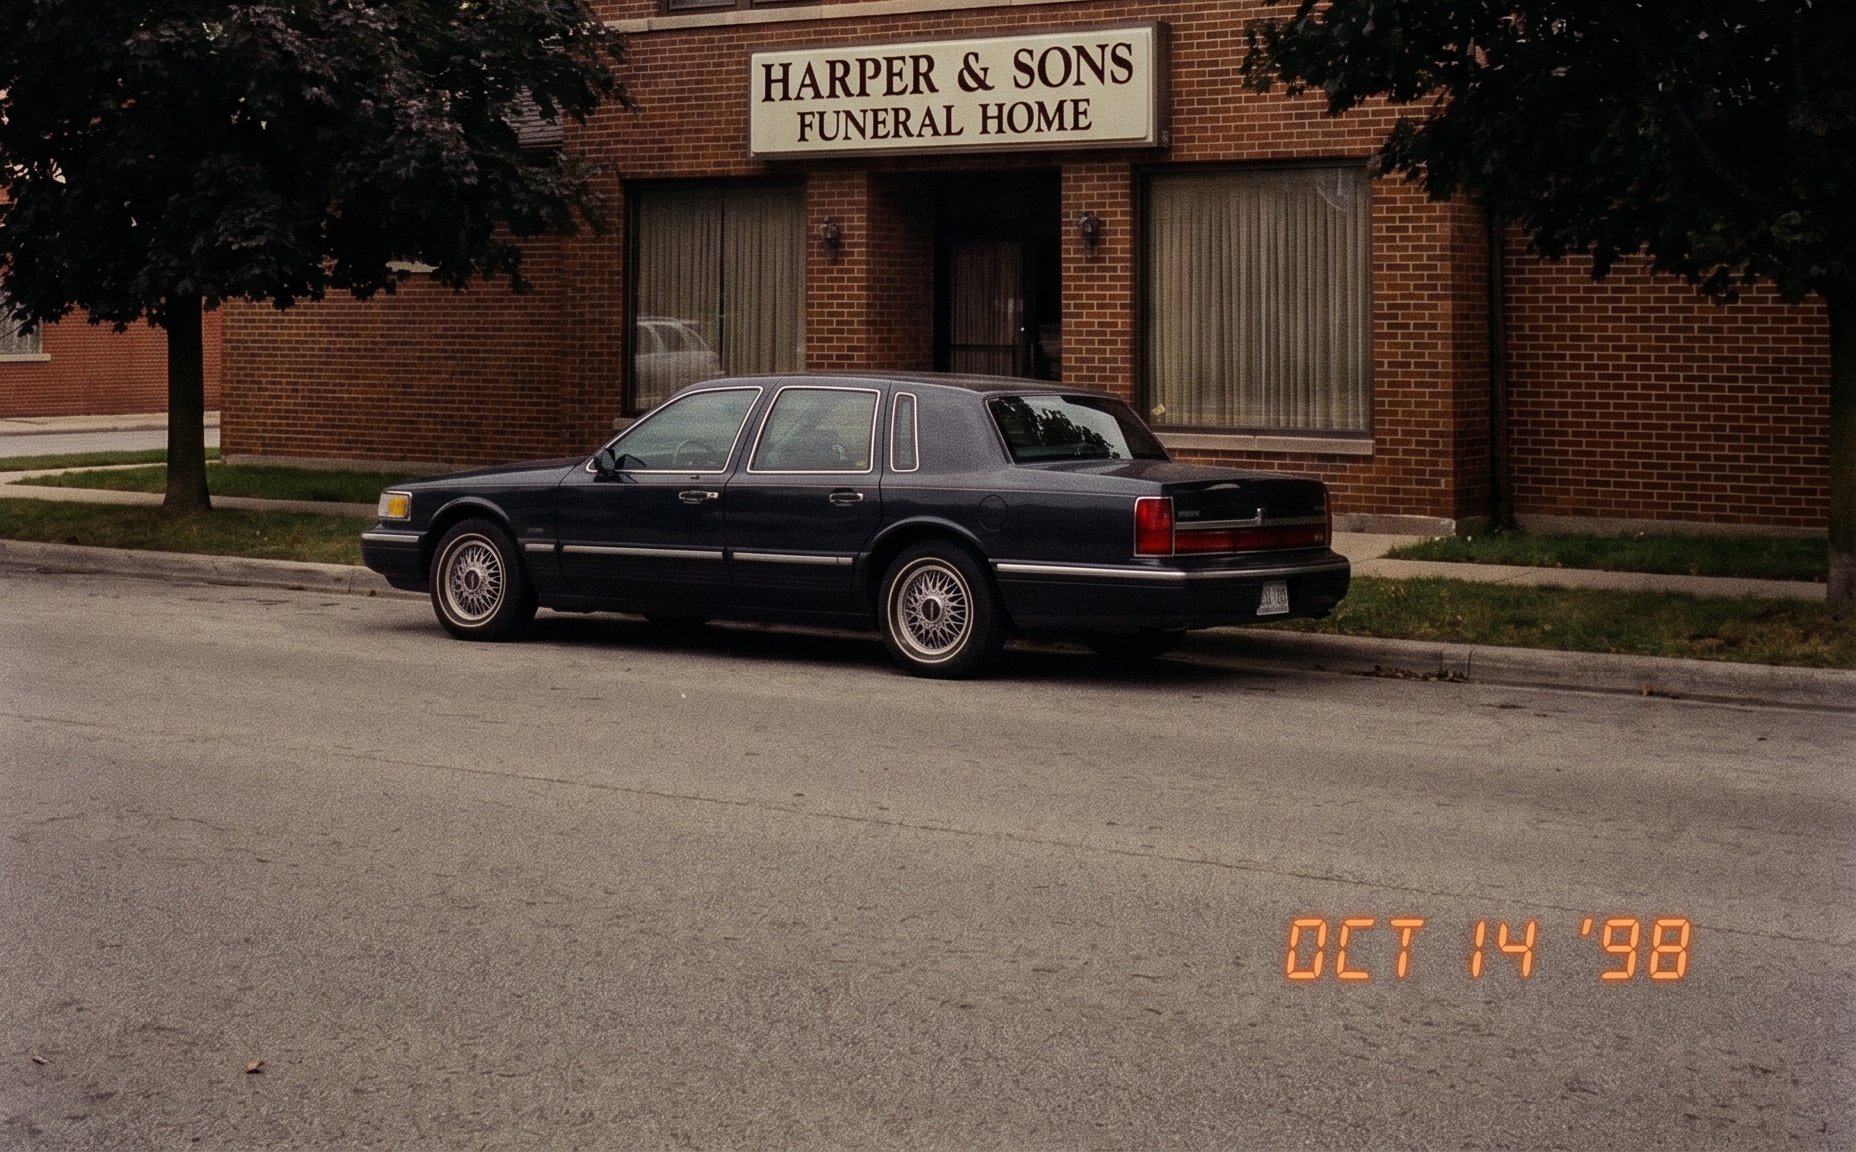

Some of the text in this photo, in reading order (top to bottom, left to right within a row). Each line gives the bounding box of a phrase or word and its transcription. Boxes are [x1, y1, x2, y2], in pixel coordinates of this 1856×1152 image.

[761, 42, 1134, 103] HARPER & SONS
[797, 98, 1093, 143] FUNERAL HOME
